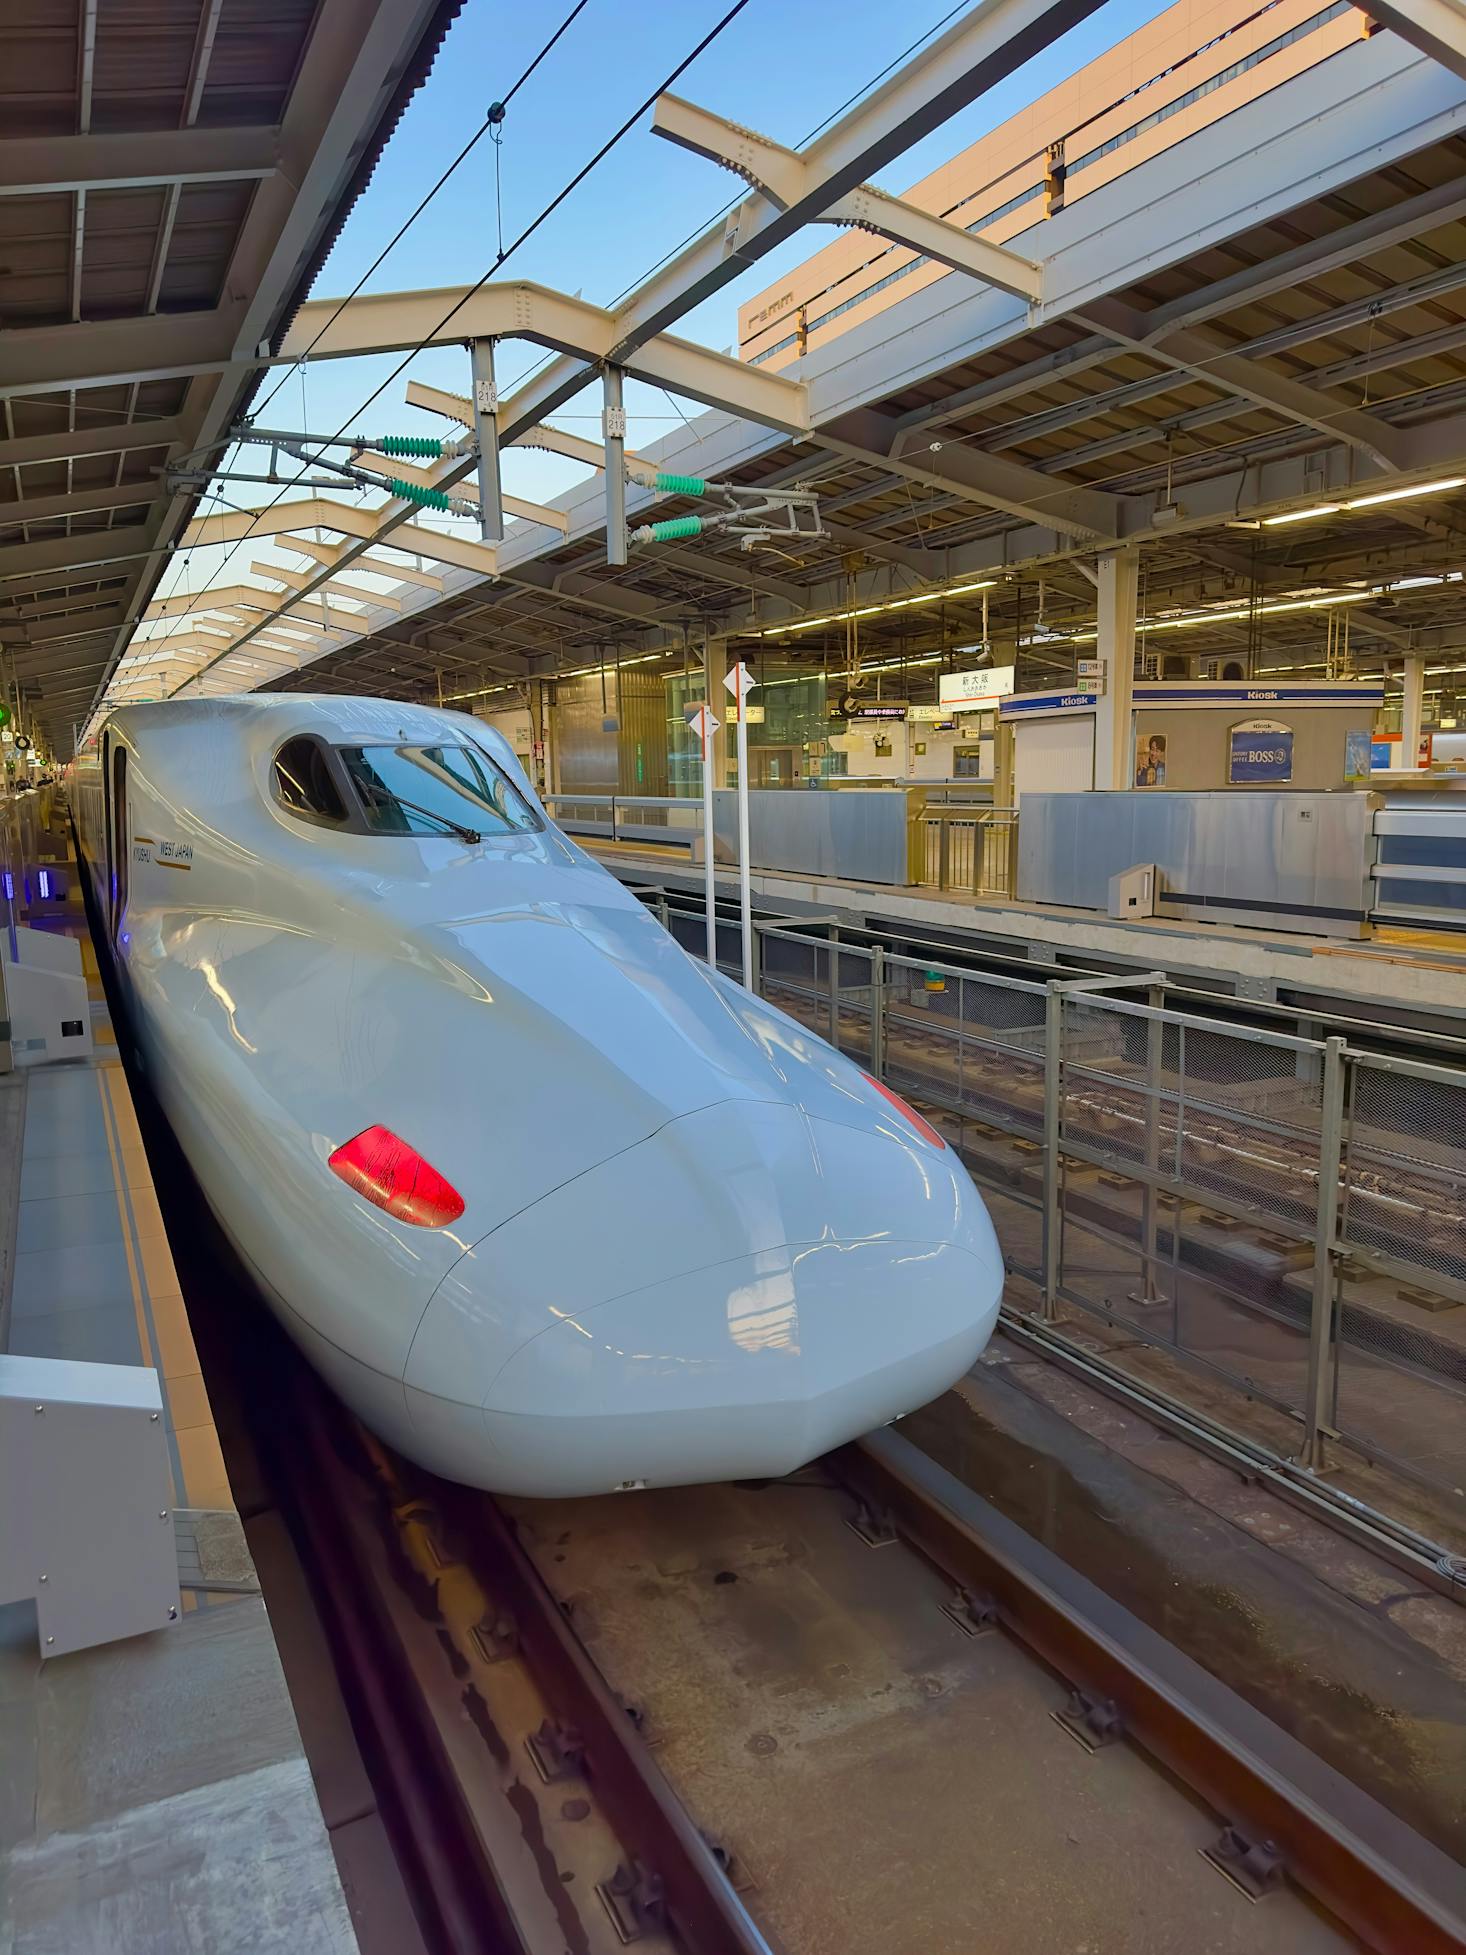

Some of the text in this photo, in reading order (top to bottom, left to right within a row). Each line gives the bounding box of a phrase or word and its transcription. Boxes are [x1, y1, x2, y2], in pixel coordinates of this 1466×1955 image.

[748, 291, 793, 329] remm
[478, 391, 496, 402] 218
[608, 419, 625, 430] 218
[1247, 691, 1278, 699] Kiosk
[1061, 696, 1088, 706] Kiosk
[1248, 751, 1274, 763] BOSS
[160, 841, 193, 860] WEST JAPAN
